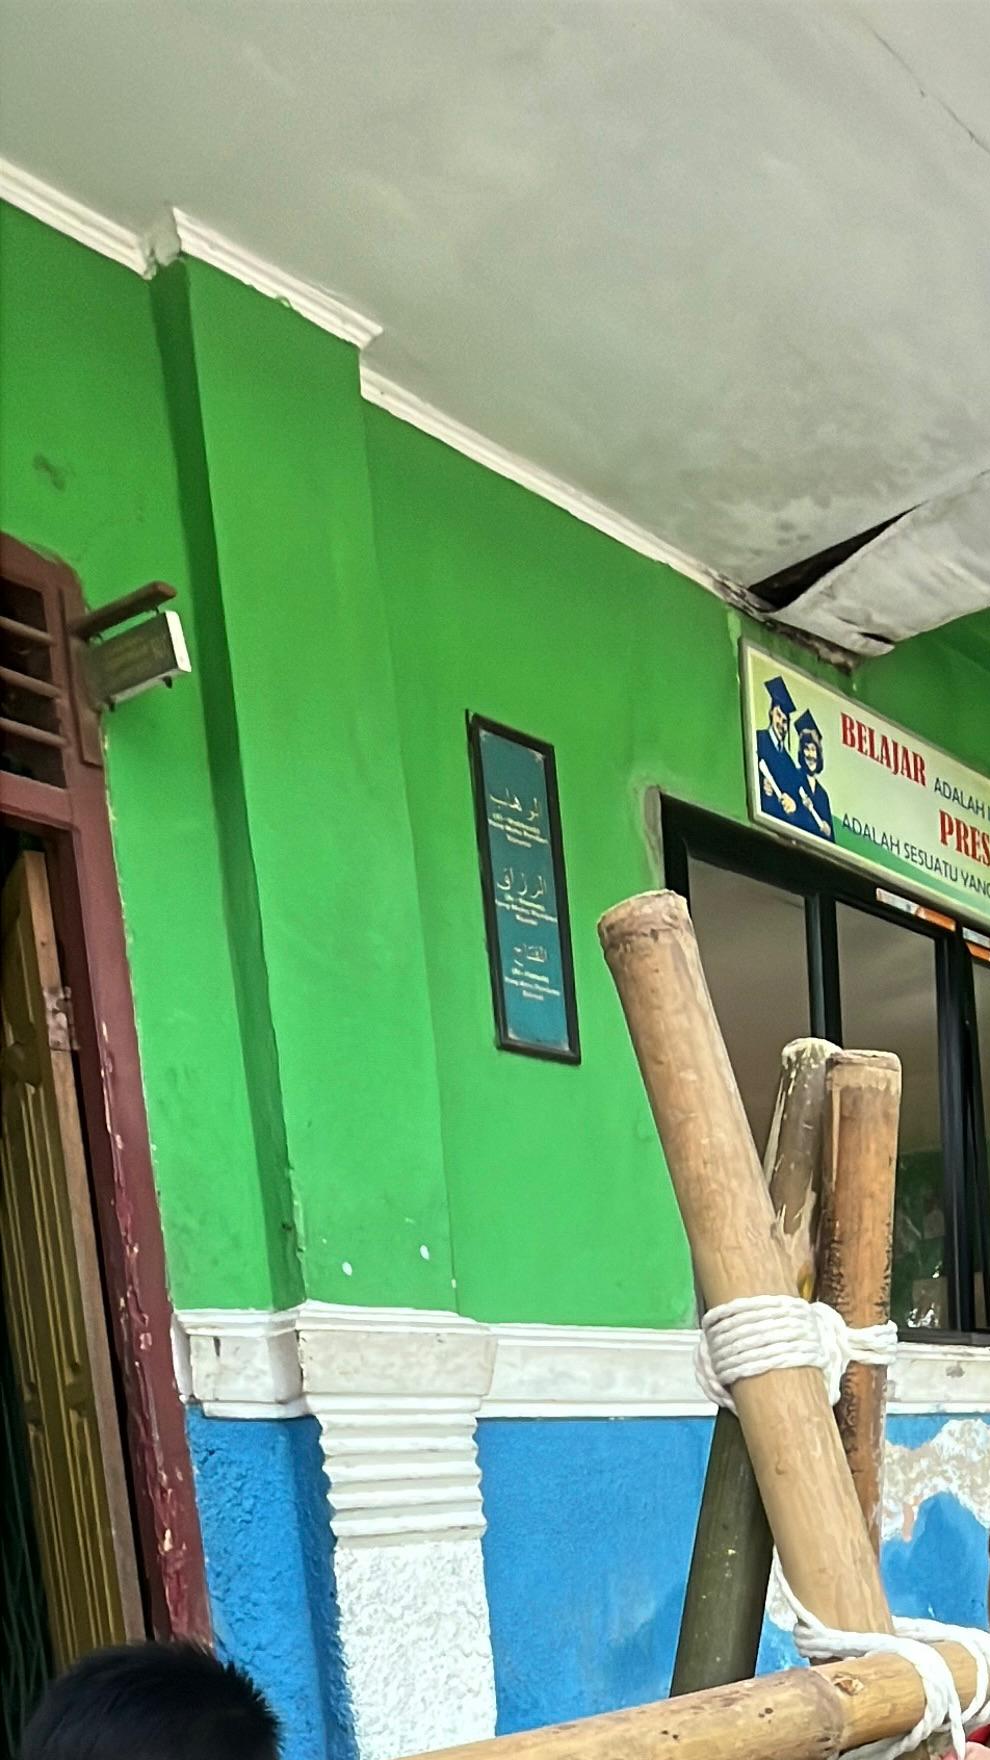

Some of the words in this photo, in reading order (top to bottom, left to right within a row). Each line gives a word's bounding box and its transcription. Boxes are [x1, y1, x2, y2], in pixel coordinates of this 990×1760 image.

[841, 712, 927, 787] BELAJAR
[934, 777, 985, 820] ADALAH
[842, 813, 901, 855] ADALAH
[904, 842, 959, 882] SESUATU
